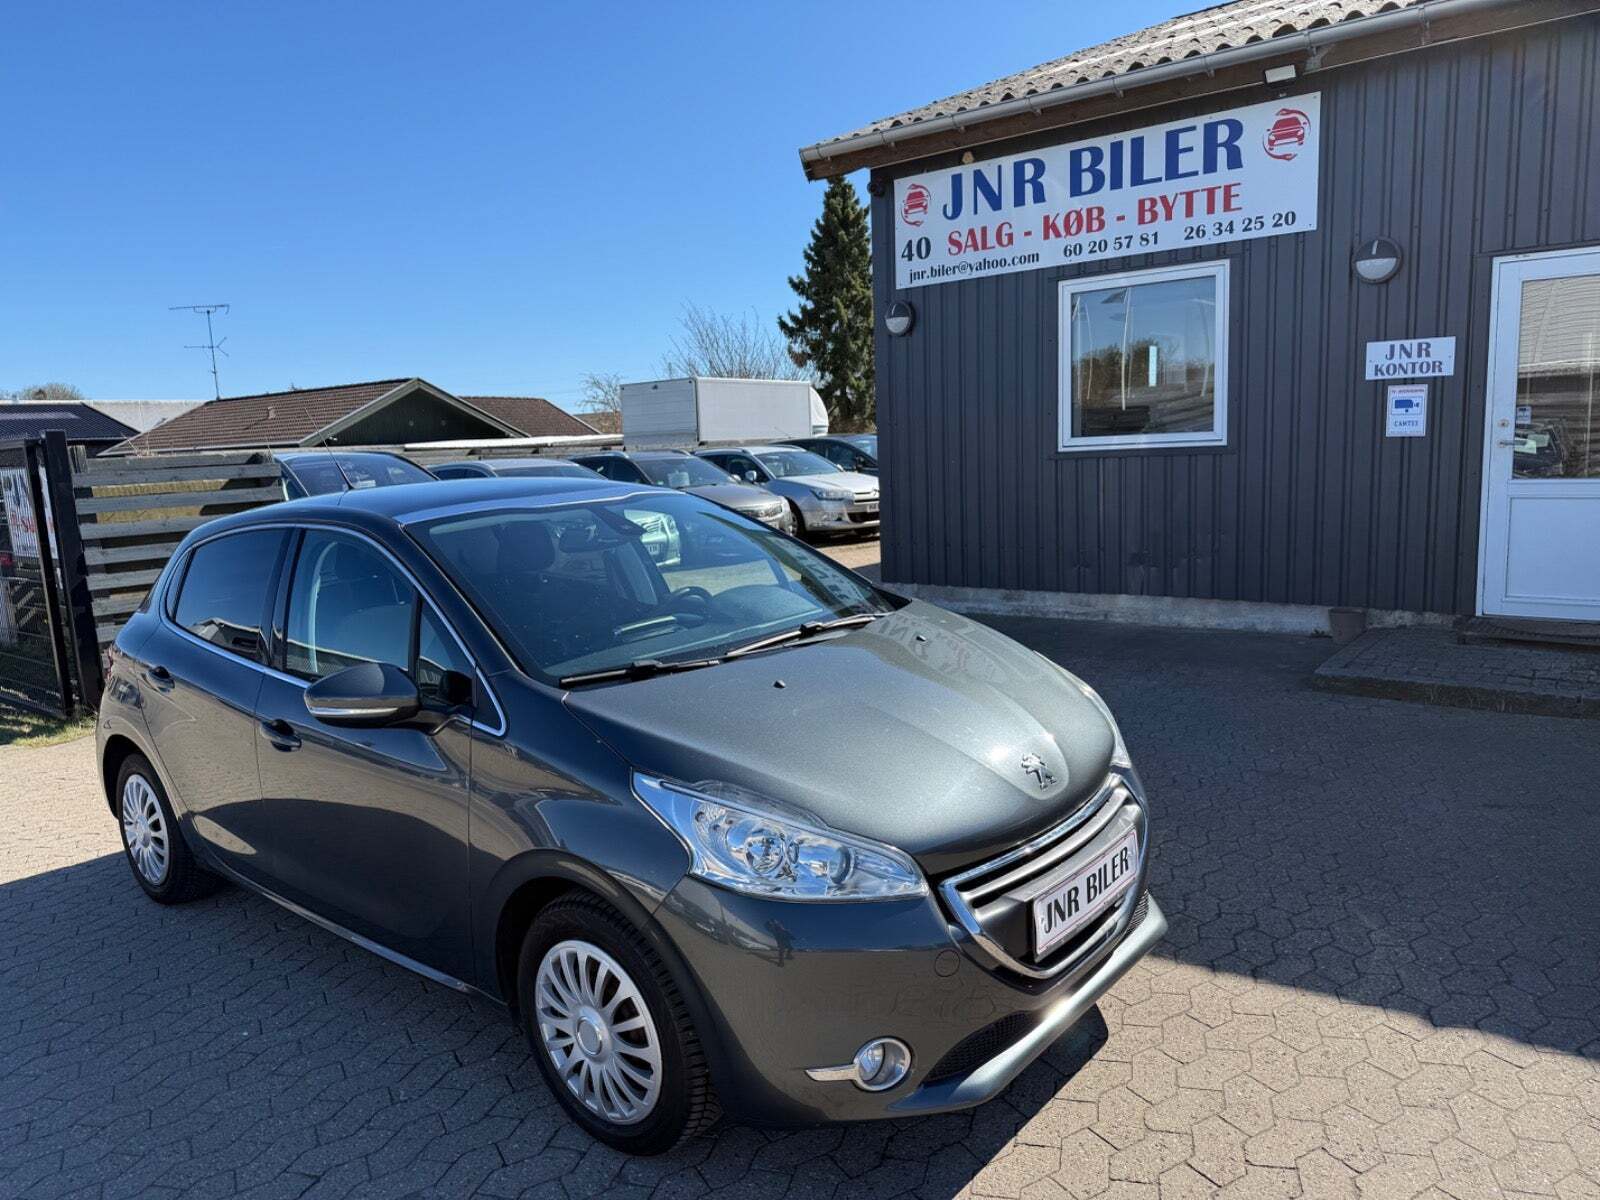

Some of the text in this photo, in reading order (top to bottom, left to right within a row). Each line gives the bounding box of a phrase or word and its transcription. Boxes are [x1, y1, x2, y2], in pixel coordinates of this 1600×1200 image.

[942, 118, 1244, 221] JNR BILER
[947, 221, 1014, 256] SALG
[1042, 205, 1106, 241] KØB
[1137, 183, 1243, 226] BYTTE
[1063, 211, 1297, 258] 60 20 57 81 26 34 25 20
[901, 236, 932, 262] 40
[909, 252, 1040, 283] jnr.biler@yahoo.com
[1374, 360, 1443, 377] KONTOR
[1385, 342, 1432, 361] JNR
[1043, 846, 1129, 934] JNR BILER
